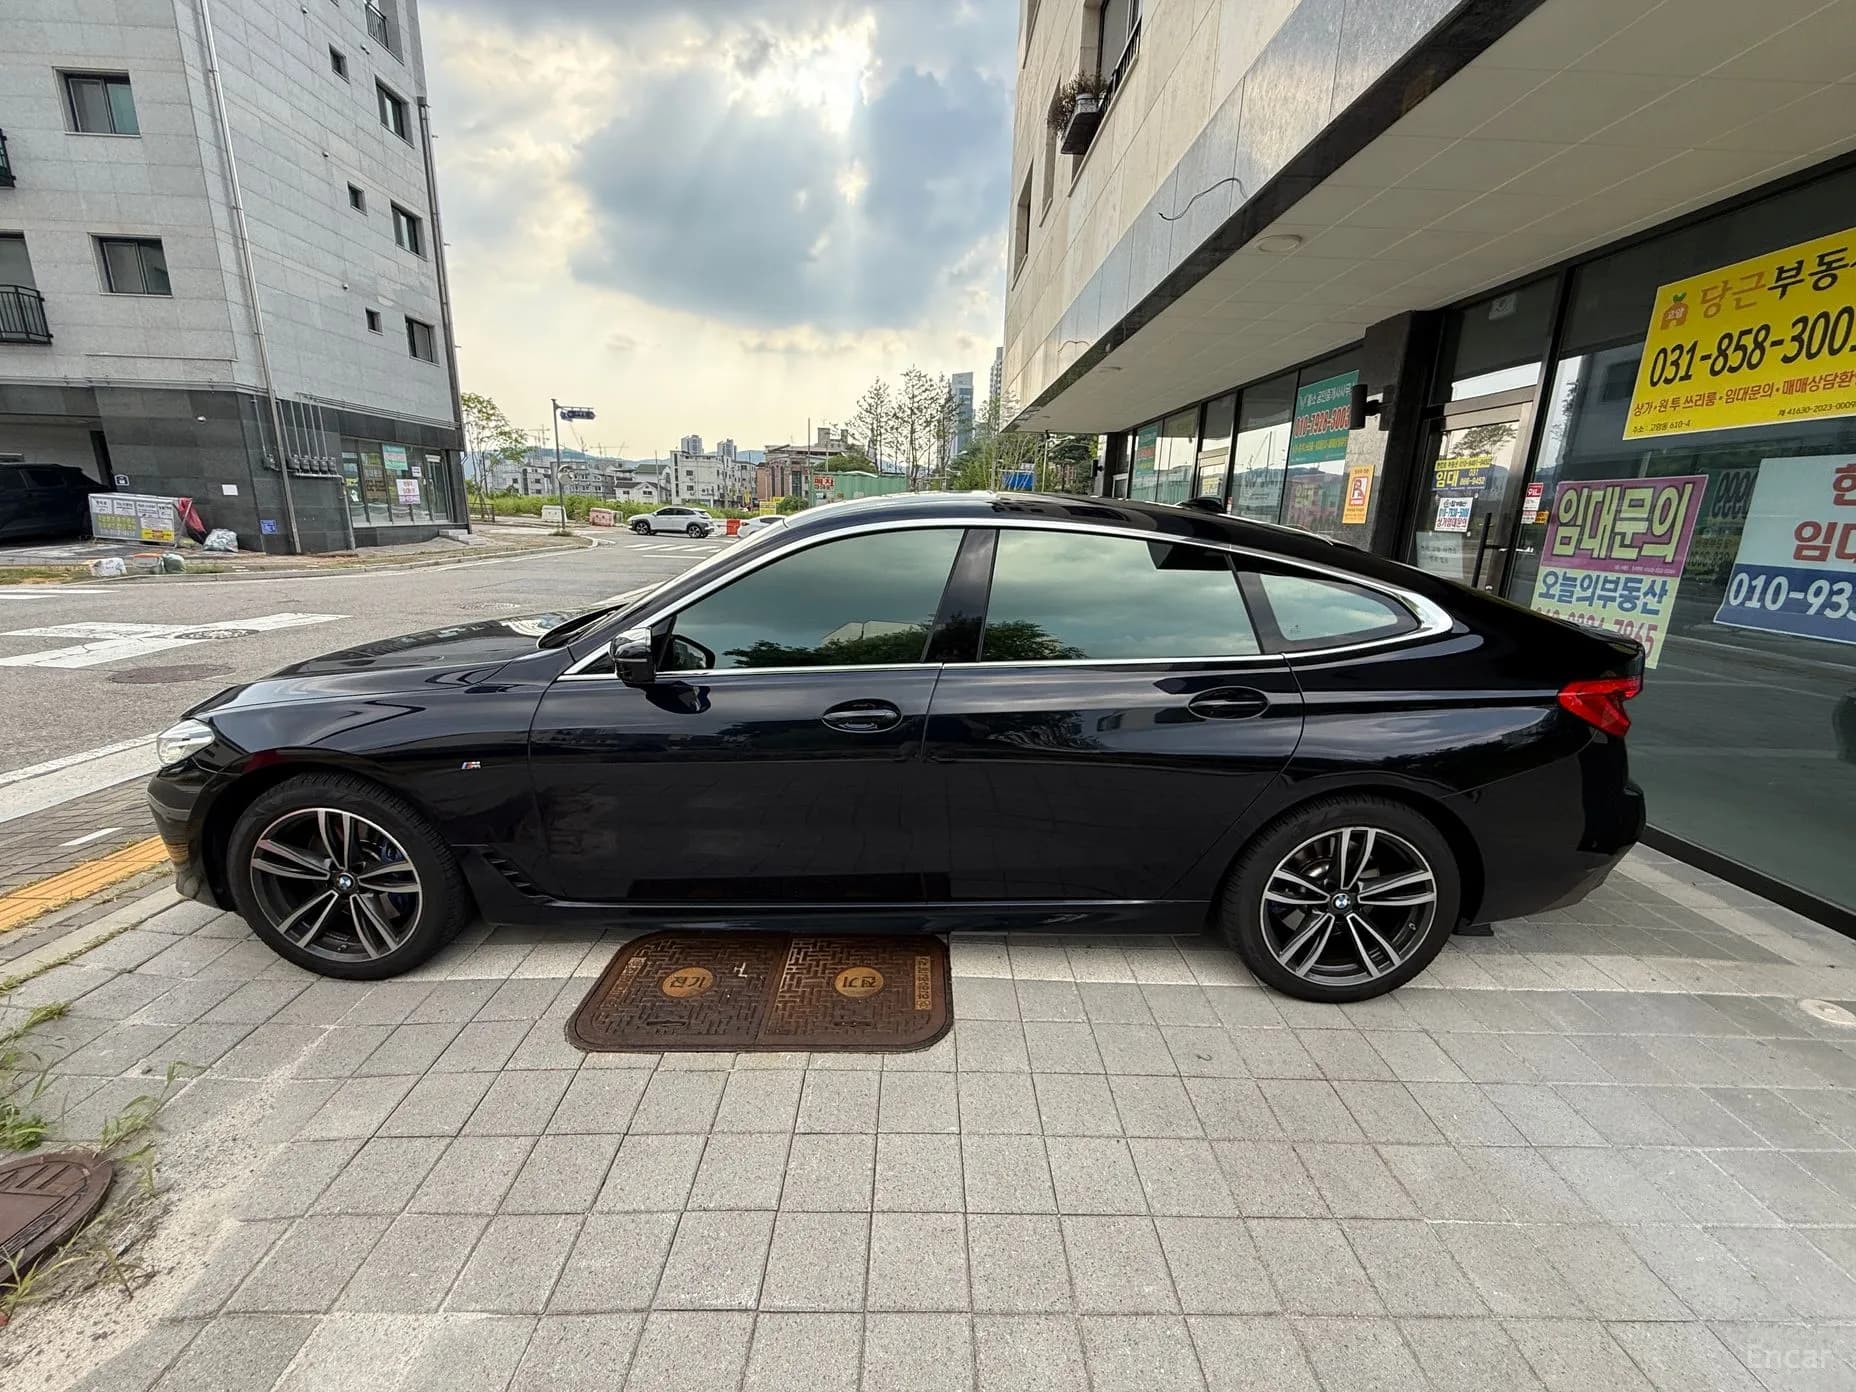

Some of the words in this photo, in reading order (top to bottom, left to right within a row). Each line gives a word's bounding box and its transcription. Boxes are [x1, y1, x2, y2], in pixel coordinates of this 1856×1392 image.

[1700, 247, 1856, 318] 당근부동
[1649, 306, 1856, 387] 031-858-300
[1782, 370, 1856, 395] 매매상담환
[1436, 470, 1459, 488] 임대
[1552, 483, 1693, 564] 임대문의
[1538, 569, 1669, 616] 오늘의부동산
[1729, 572, 1856, 623] 010-93
[669, 974, 706, 989] 전기
[842, 976, 877, 988] 전기
